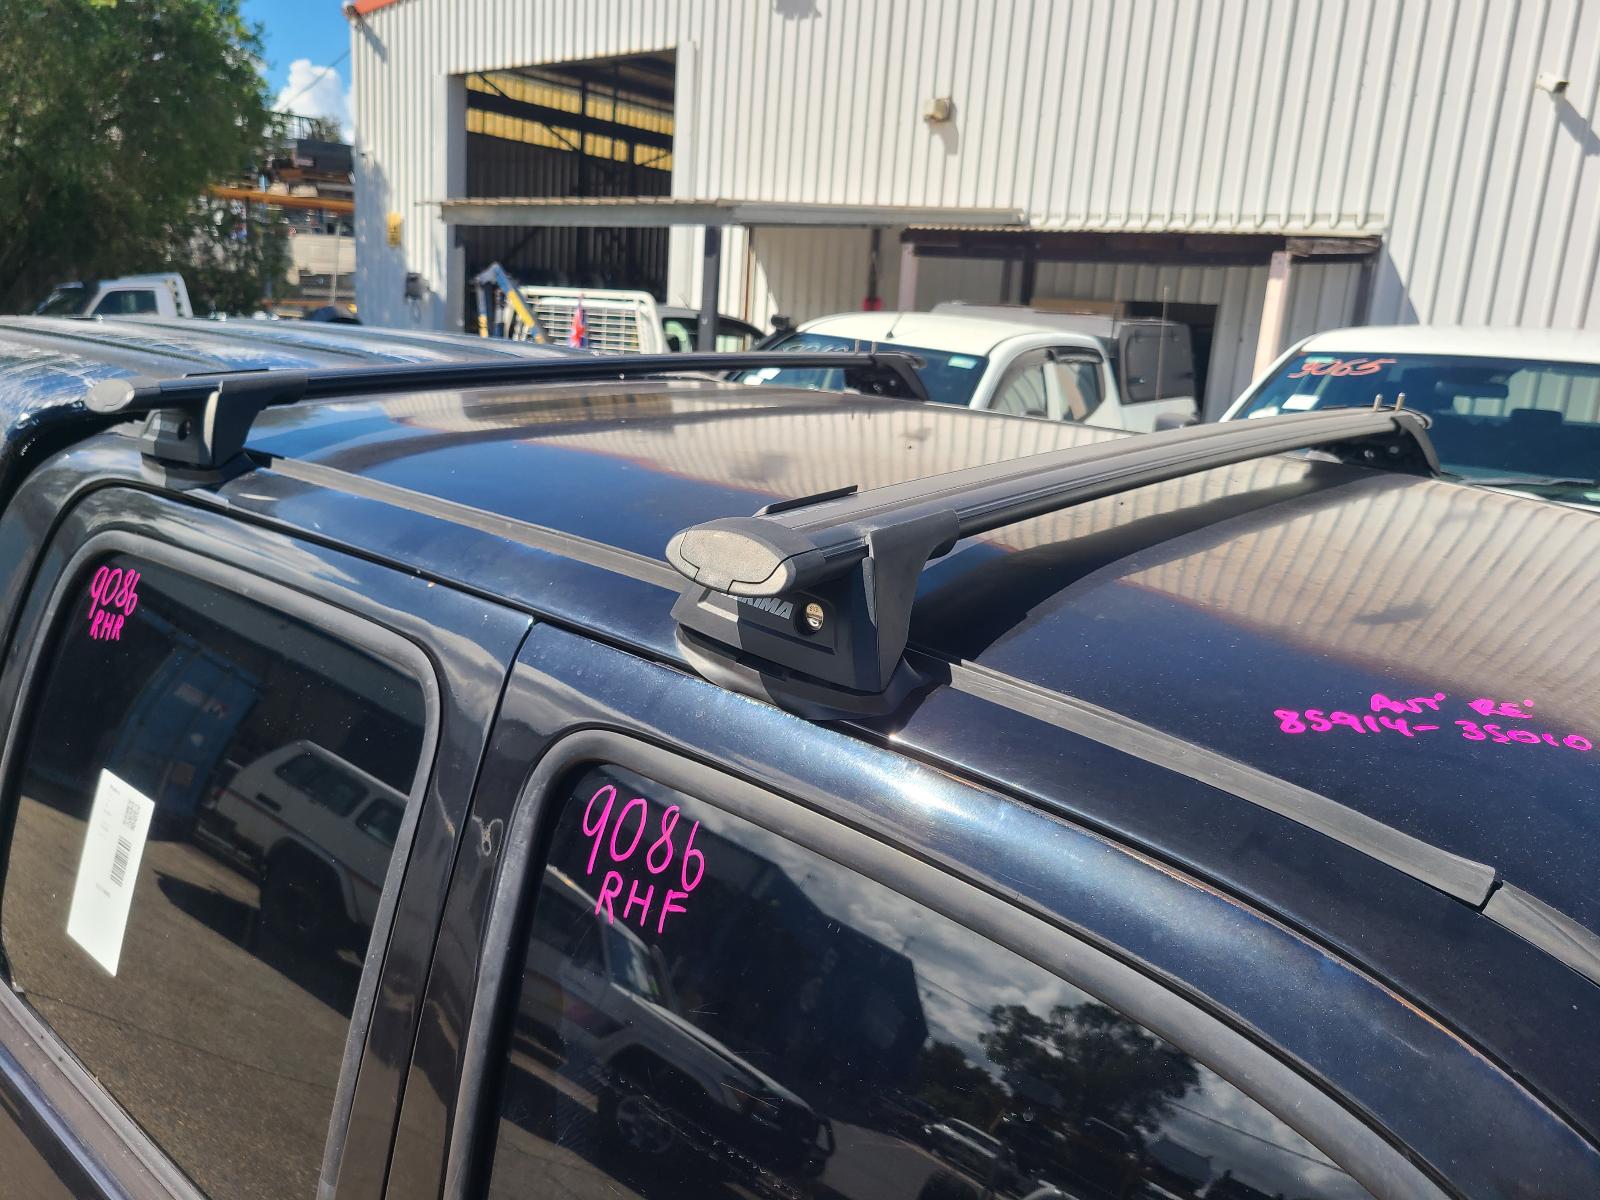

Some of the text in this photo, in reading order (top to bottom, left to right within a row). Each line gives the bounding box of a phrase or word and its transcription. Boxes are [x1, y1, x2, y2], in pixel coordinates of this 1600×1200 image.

[88, 565, 141, 620] 9086
[89, 608, 125, 641] RHR
[582, 784, 705, 892] 9086
[595, 870, 689, 934] RHF
